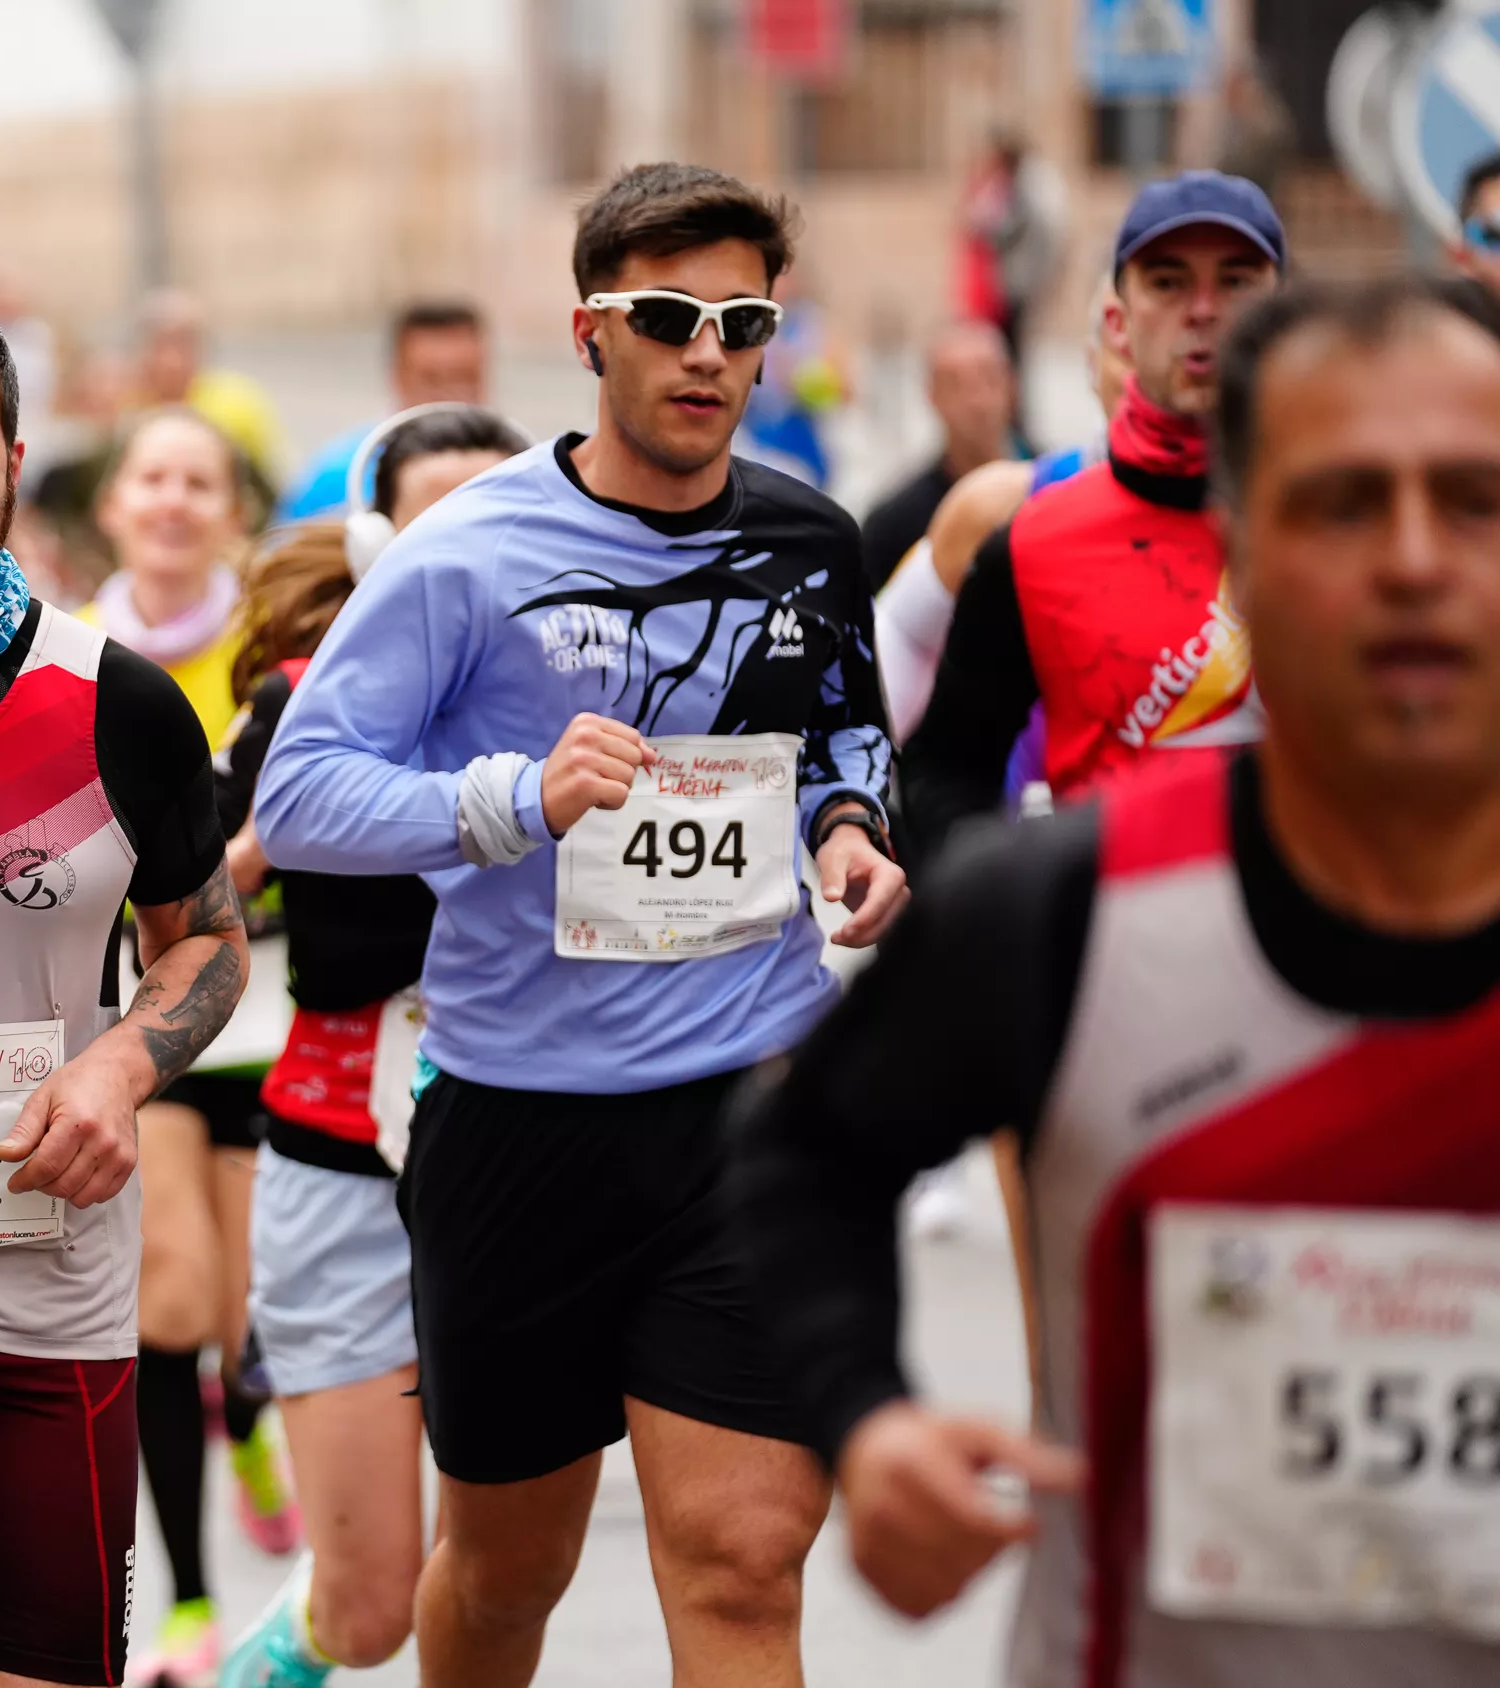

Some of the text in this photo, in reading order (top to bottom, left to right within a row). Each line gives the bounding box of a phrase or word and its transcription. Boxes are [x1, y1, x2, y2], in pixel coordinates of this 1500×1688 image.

[554, 645, 619, 673] OR DIE
[622, 820, 748, 878] 494
[1276, 1365, 1500, 1487] 558
